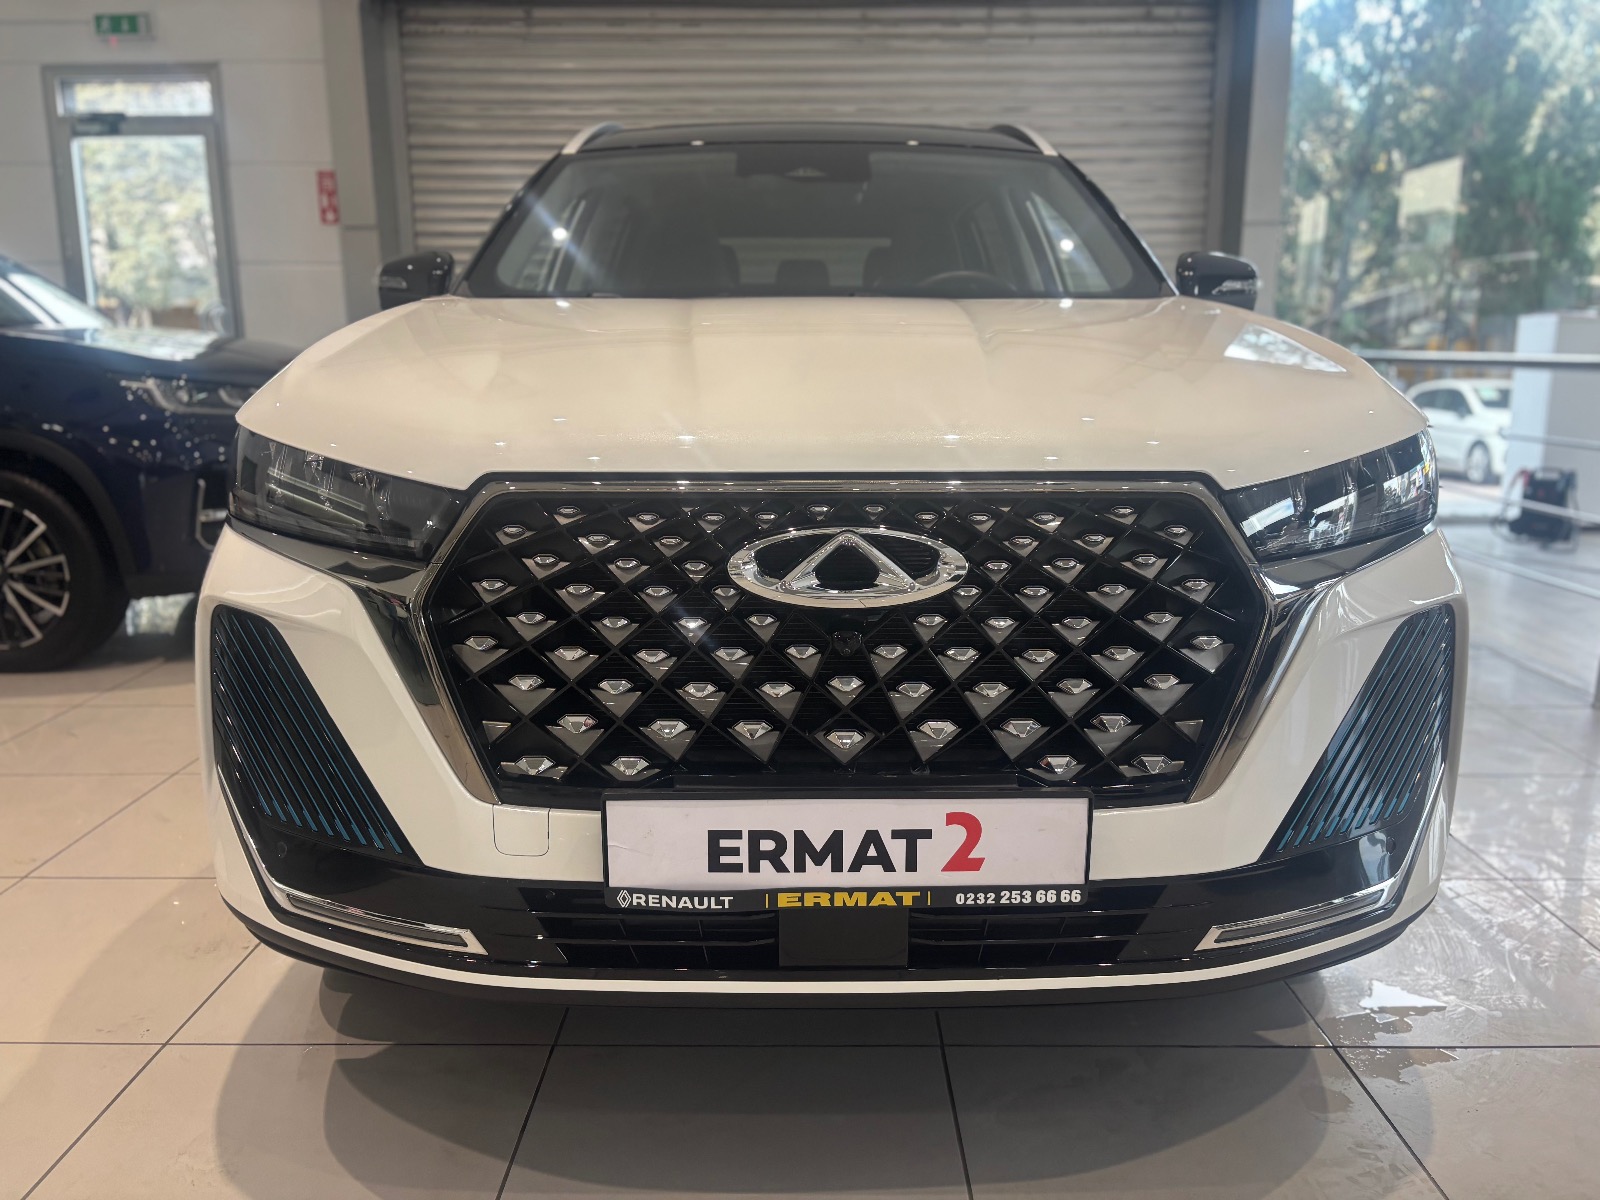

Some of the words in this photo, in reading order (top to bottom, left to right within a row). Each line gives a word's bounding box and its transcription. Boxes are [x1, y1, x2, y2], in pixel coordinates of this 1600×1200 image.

[707, 828, 933, 873] ERMAT
[940, 811, 987, 873] 2
[632, 893, 734, 909] RENAULT
[777, 891, 921, 908] ERMAT
[955, 892, 996, 905] 0232
[1000, 890, 1032, 904] 253
[1035, 889, 1057, 903] 66
[1060, 889, 1082, 903] 66
